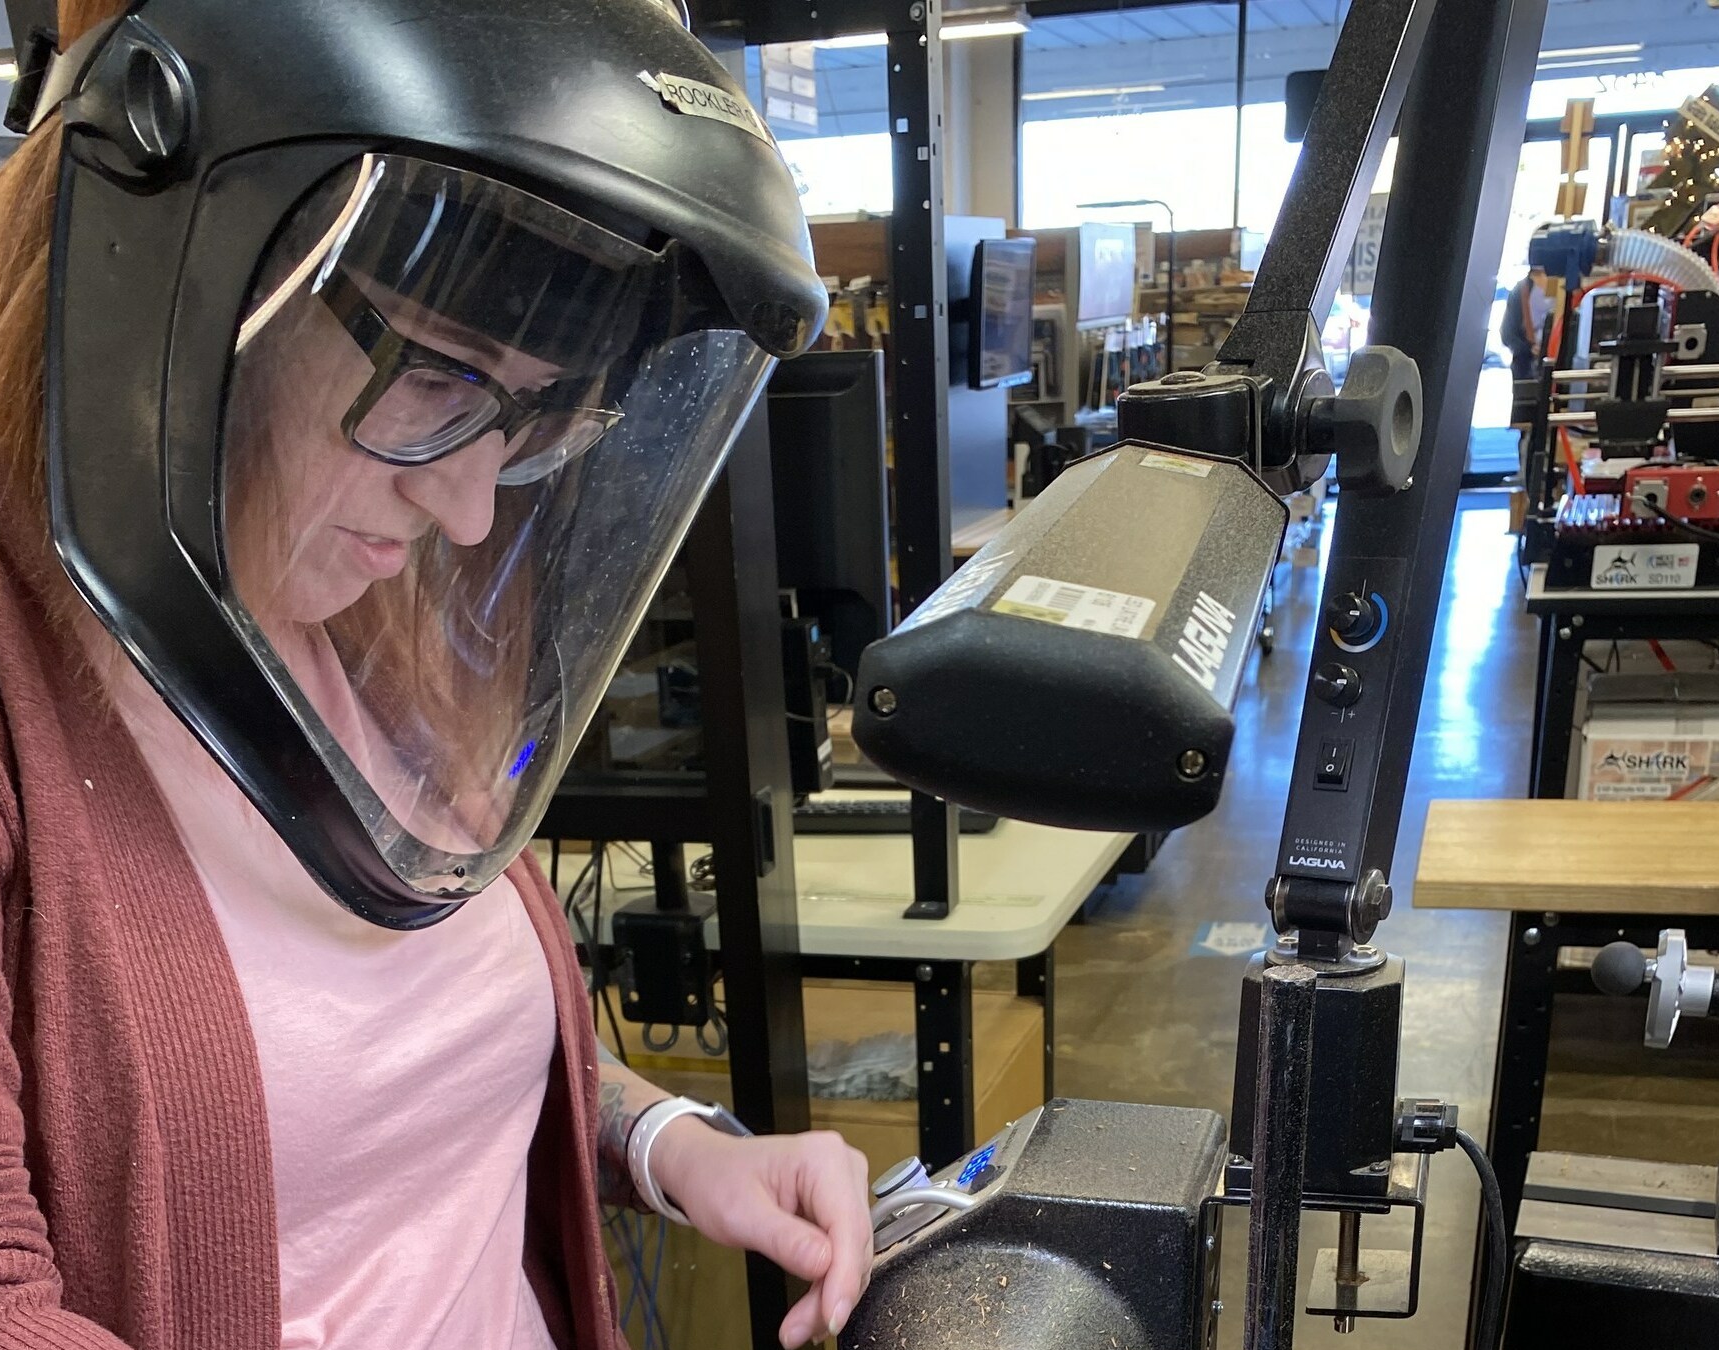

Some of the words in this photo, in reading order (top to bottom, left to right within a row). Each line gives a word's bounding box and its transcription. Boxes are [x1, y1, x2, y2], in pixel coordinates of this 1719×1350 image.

[666, 83, 745, 120] ROCKLER
[1172, 591, 1235, 691] LAGUNA
[1295, 838, 1334, 846] DESIGNED
[1296, 845, 1343, 854] CALIFORNIA
[1289, 856, 1346, 870] LAGUNA
